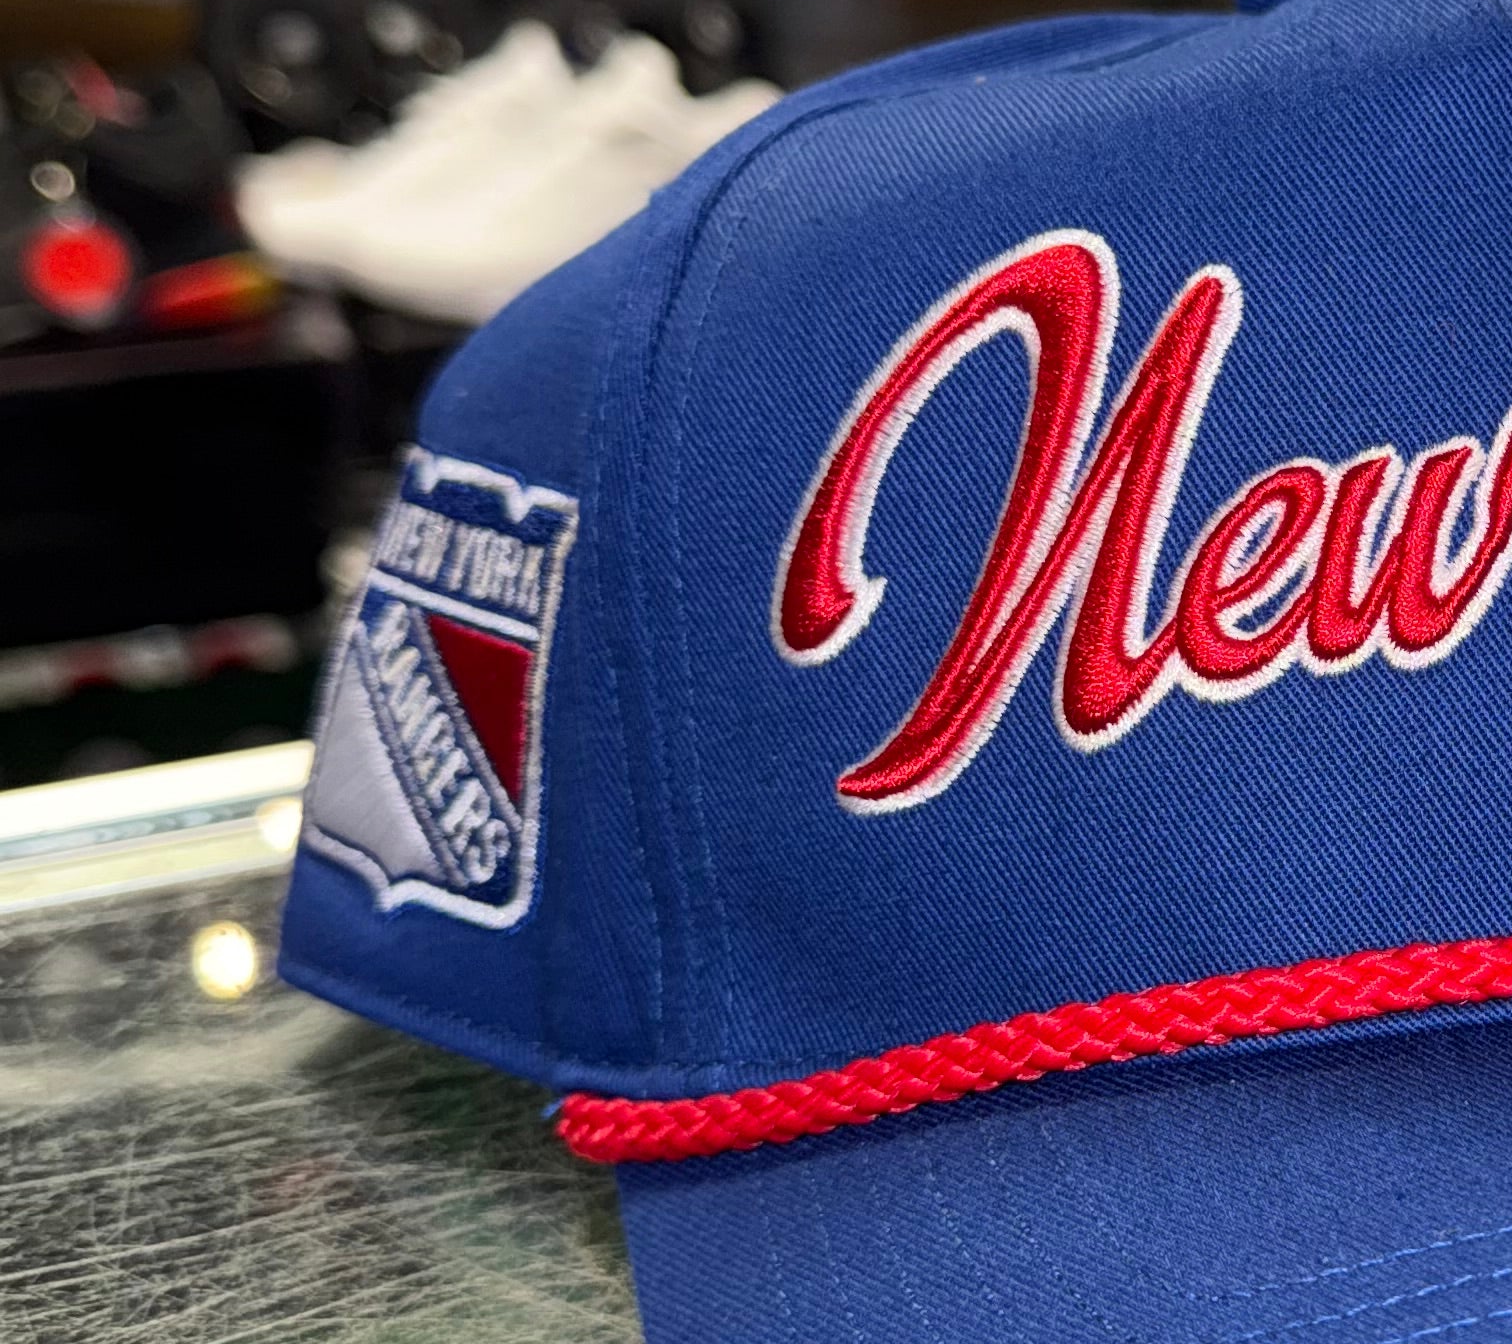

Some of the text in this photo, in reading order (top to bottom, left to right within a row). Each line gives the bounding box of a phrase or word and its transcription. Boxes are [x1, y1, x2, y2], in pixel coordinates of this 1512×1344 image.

[372, 501, 547, 616] NEW YORK
[371, 599, 511, 885] RANGERS
